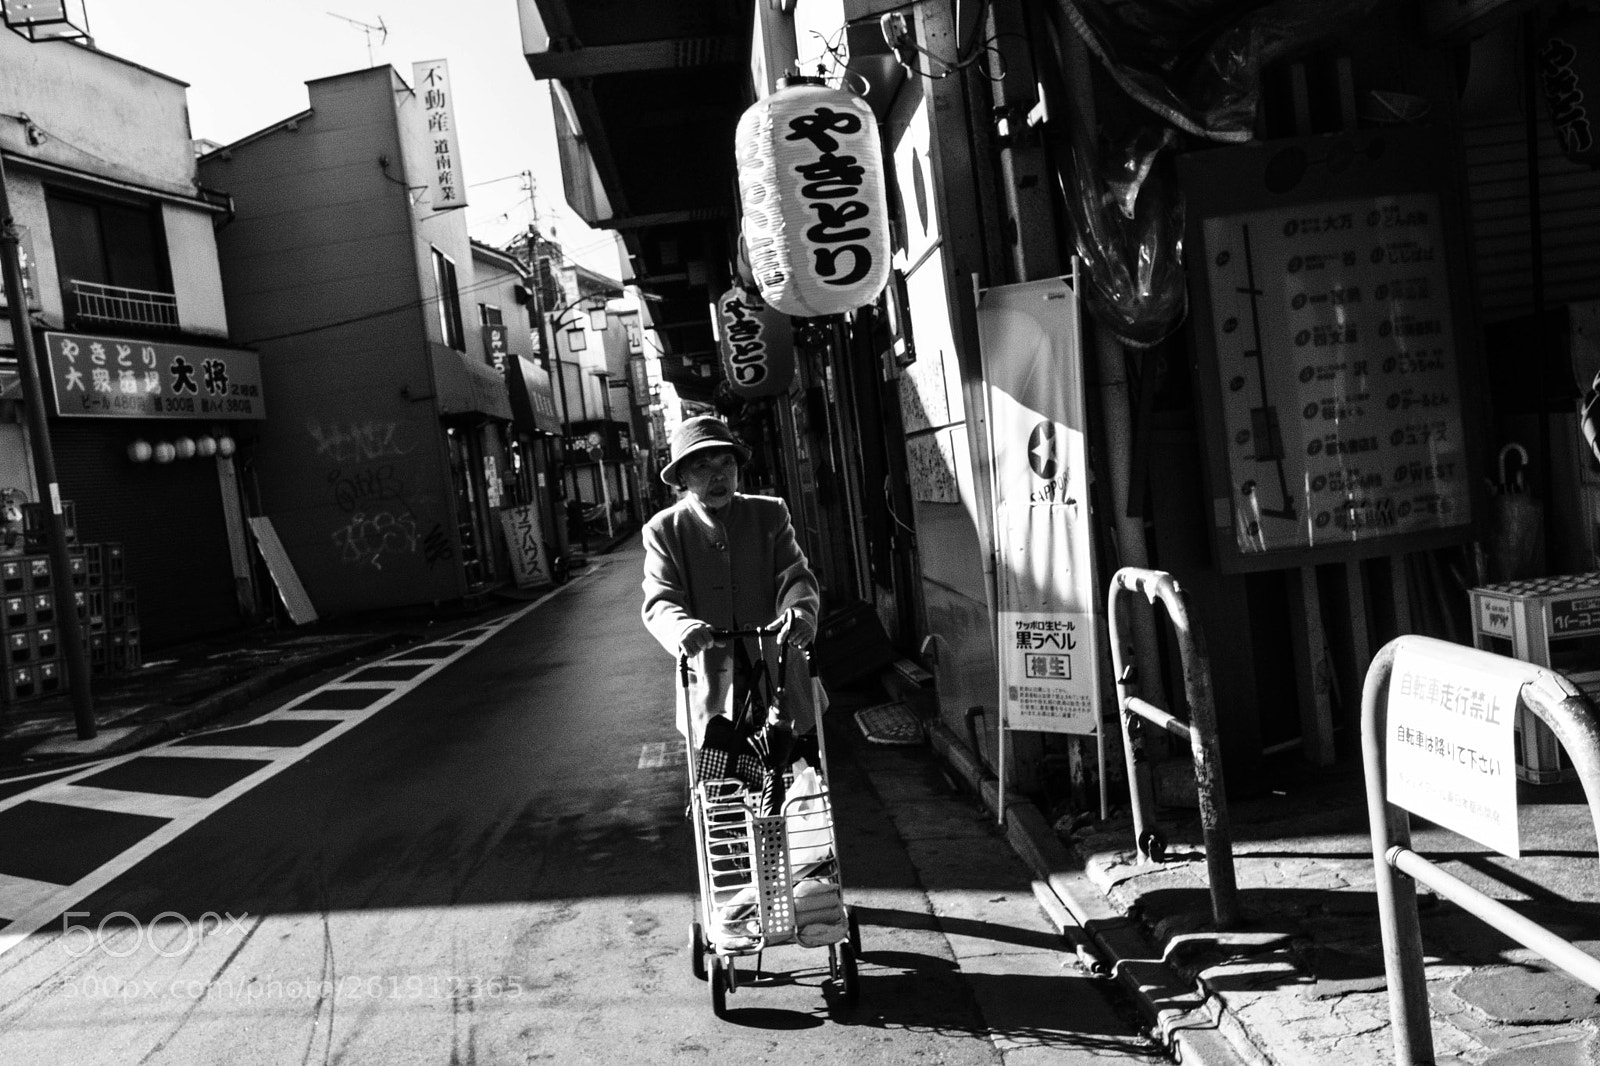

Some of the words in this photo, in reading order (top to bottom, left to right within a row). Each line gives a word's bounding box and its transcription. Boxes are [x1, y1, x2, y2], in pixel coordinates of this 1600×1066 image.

[423, 65, 449, 133] 不動産
[434, 139, 456, 202] 道南産業
[786, 107, 872, 286] やきとり
[61, 338, 158, 369] やきとり
[724, 297, 768, 386] やきとり
[64, 366, 162, 395] 大衆酒場
[171, 355, 229, 395] 大将
[1410, 461, 1456, 482] WEST
[1016, 620, 1076, 632] サッポロ生ビール
[1016, 631, 1076, 651] 黒ラベル
[1400, 671, 1502, 727] 自転車走行禁止
[1397, 724, 1502, 777] 自転車は降りて下さい
